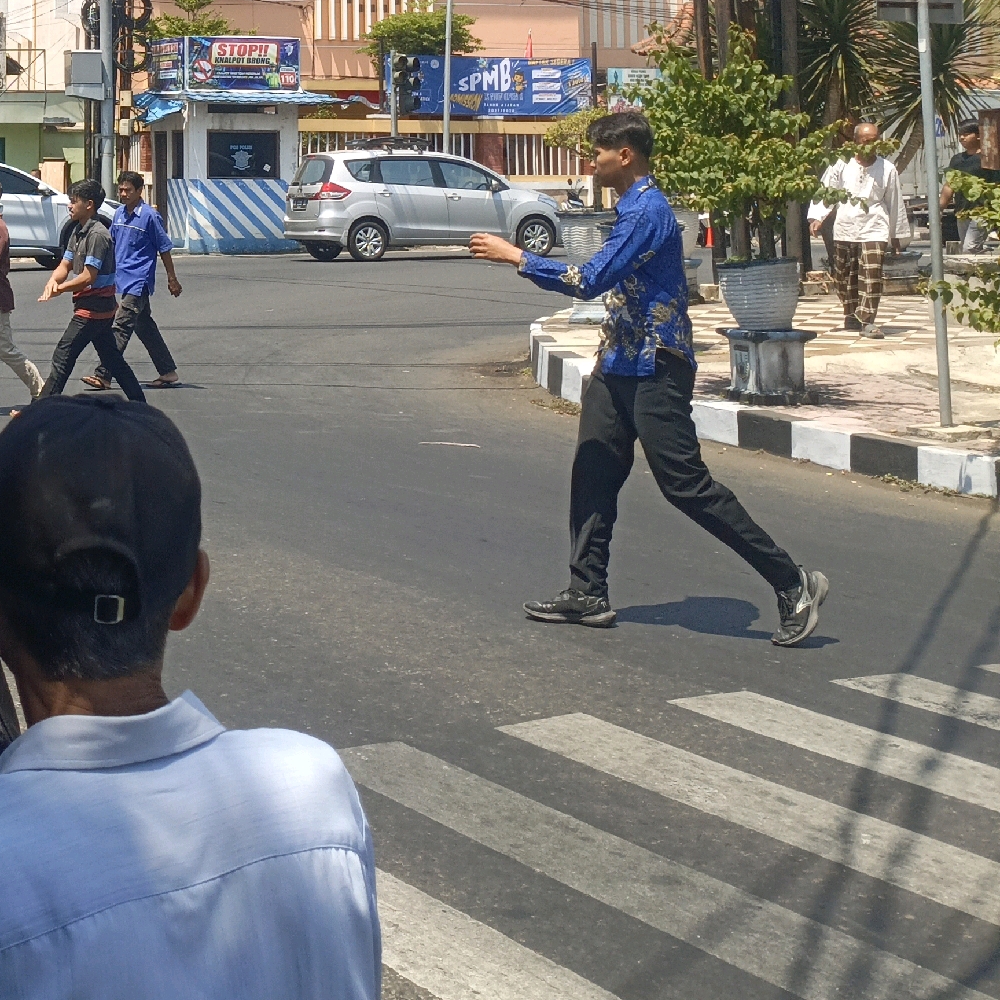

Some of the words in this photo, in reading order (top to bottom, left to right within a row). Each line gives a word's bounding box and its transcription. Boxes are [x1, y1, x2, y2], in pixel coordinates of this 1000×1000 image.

[217, 43, 270, 57] STOP!!
[214, 56, 245, 65] KNALPOT
[246, 57, 271, 65] BRONG
[280, 74, 294, 85] 110
[458, 57, 512, 92] SPMB
